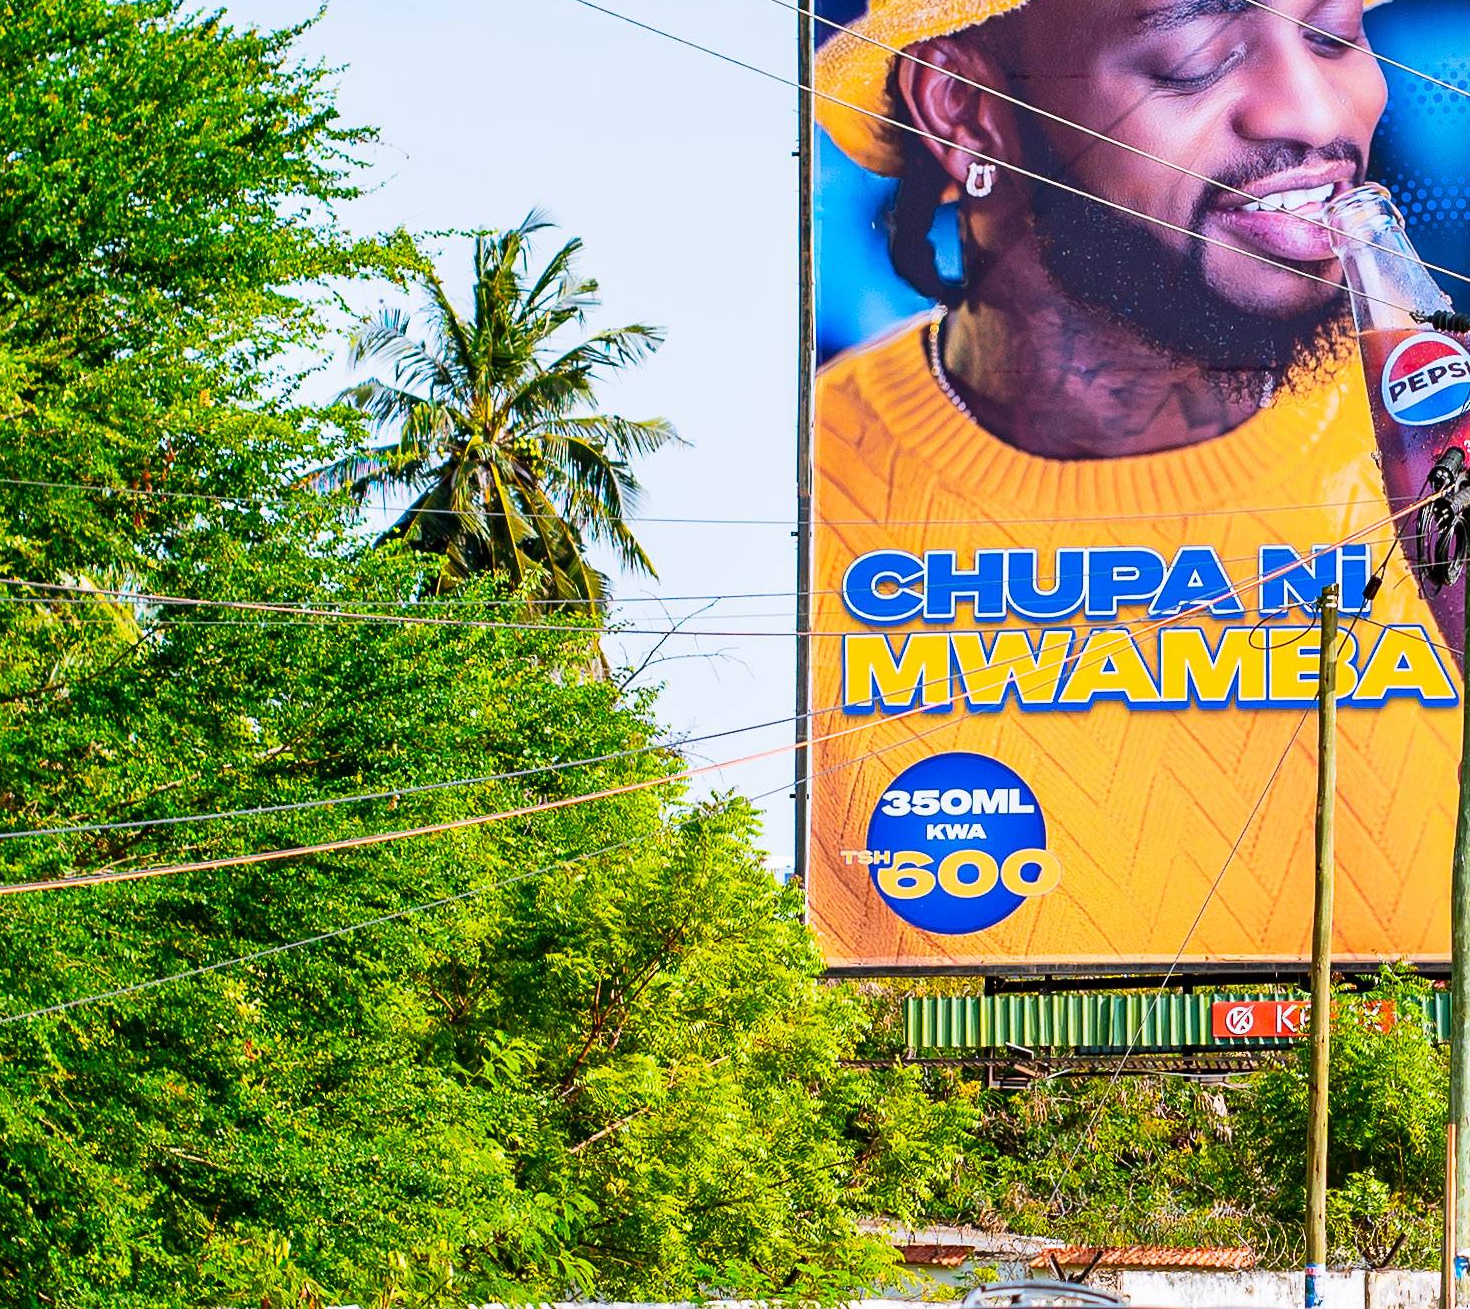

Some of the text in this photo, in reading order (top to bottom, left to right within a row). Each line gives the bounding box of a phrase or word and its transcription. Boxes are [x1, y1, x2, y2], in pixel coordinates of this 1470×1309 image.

[841, 545, 1241, 622] CHUPA
[841, 625, 1460, 714] MWAMBA
[881, 788, 1035, 817] 350ML
[926, 823, 987, 841] KWA
[840, 848, 1063, 900] TSH 600
